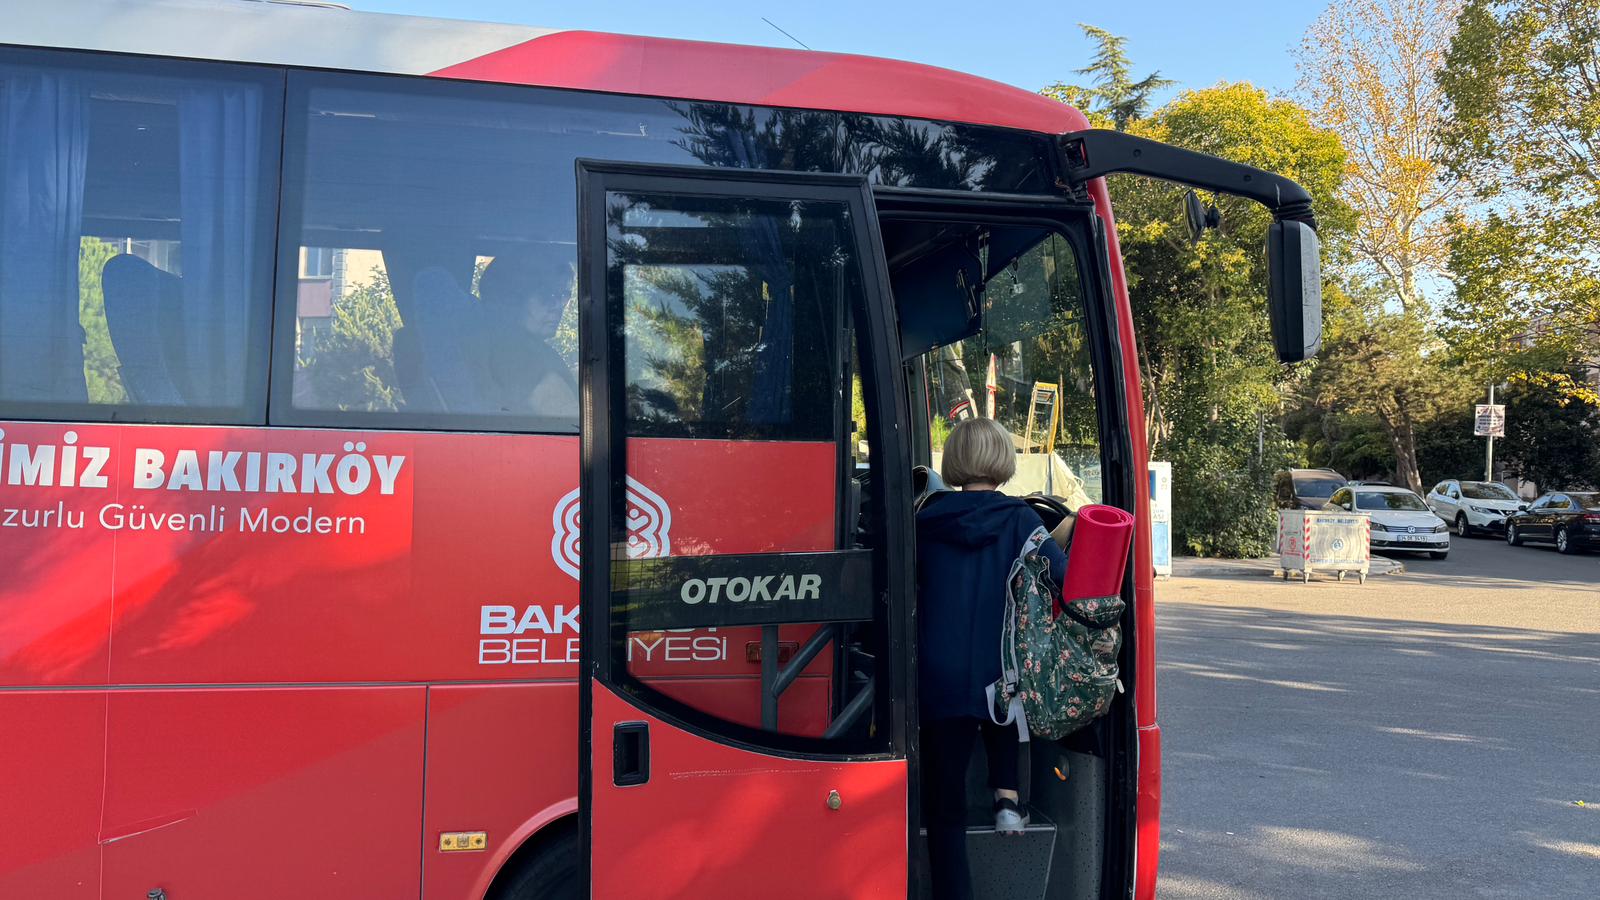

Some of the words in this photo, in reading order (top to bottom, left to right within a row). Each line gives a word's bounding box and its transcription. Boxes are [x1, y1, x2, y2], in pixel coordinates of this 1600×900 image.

[134, 441, 406, 496] BAKIRKÖY
[99, 503, 225, 532] Güvenli
[239, 506, 365, 534] Modern
[680, 572, 822, 605] OTOKAR
